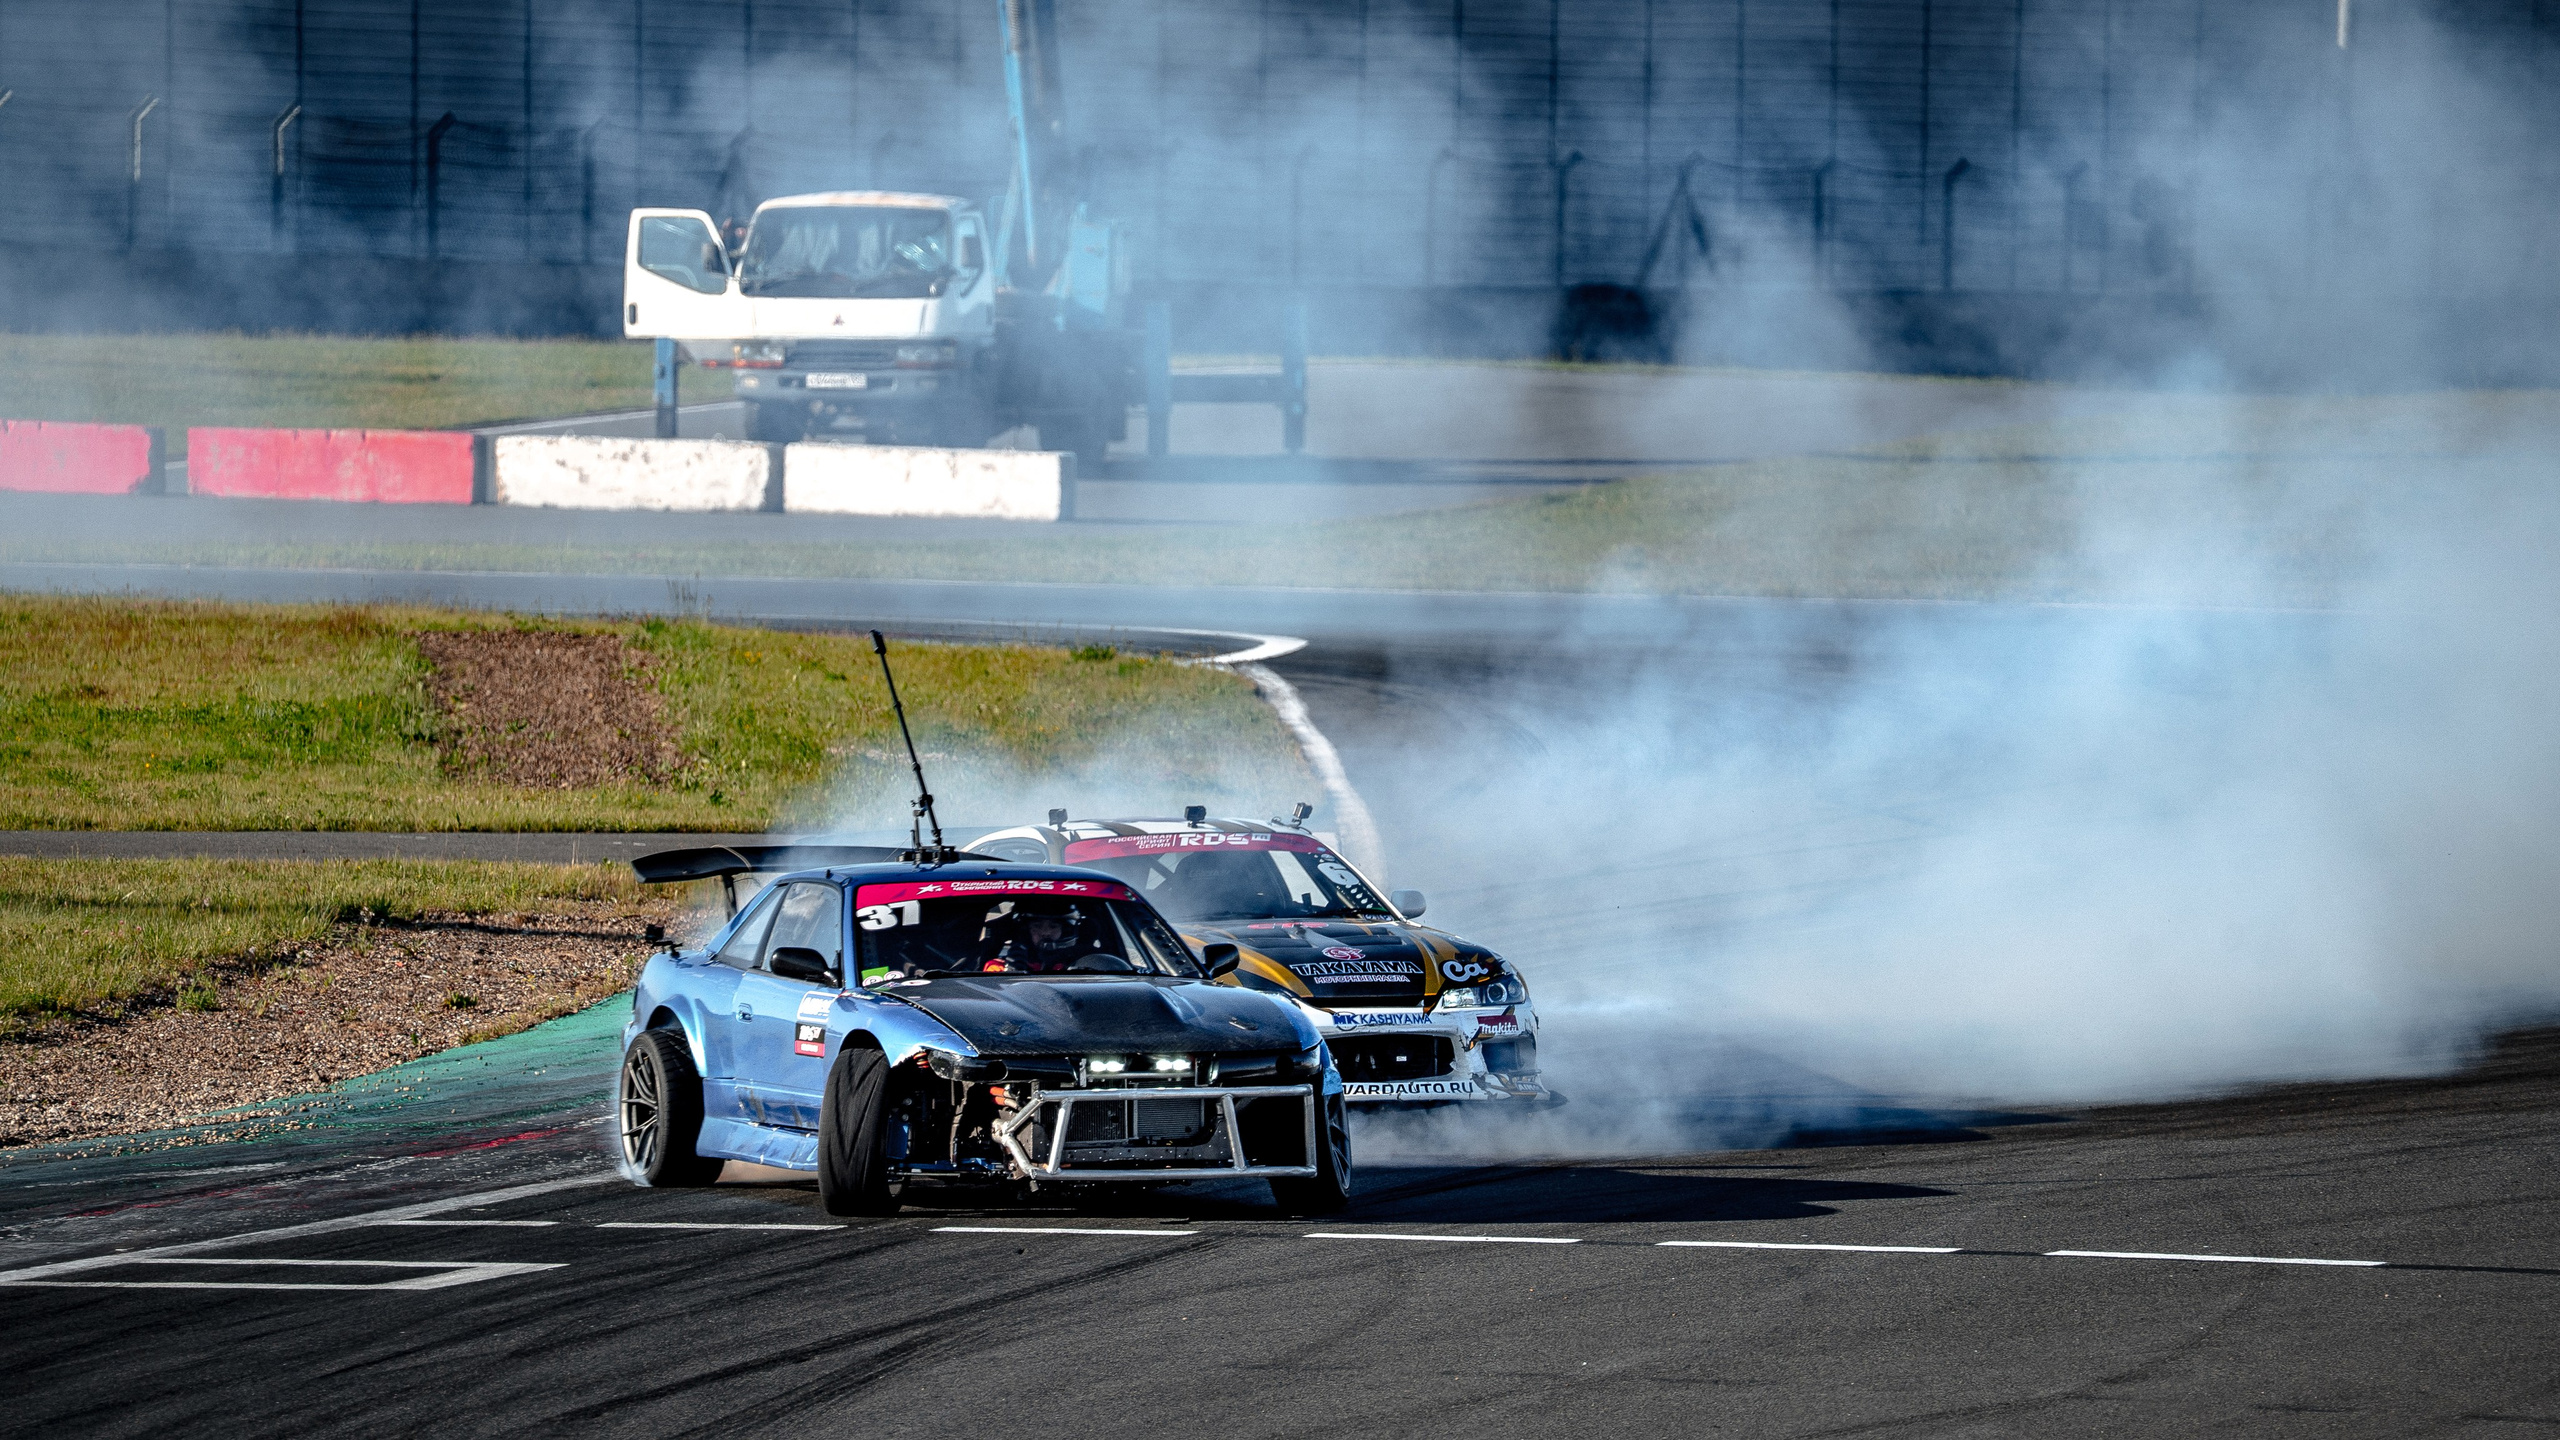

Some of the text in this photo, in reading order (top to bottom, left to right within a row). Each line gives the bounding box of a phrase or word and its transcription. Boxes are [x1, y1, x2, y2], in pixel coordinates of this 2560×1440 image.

[1108, 835, 1173, 844] РОССИЙСКАЯ
[1178, 833, 1250, 847] RDS
[1007, 880, 1054, 890] RDS
[1289, 960, 1424, 976] TAKAYAMA
[1313, 974, 1411, 984] МОТОРНЫЕ МАСЛА
[1333, 1012, 1432, 1025] MK KASHIYAMA
[1479, 1022, 1518, 1034] makita
